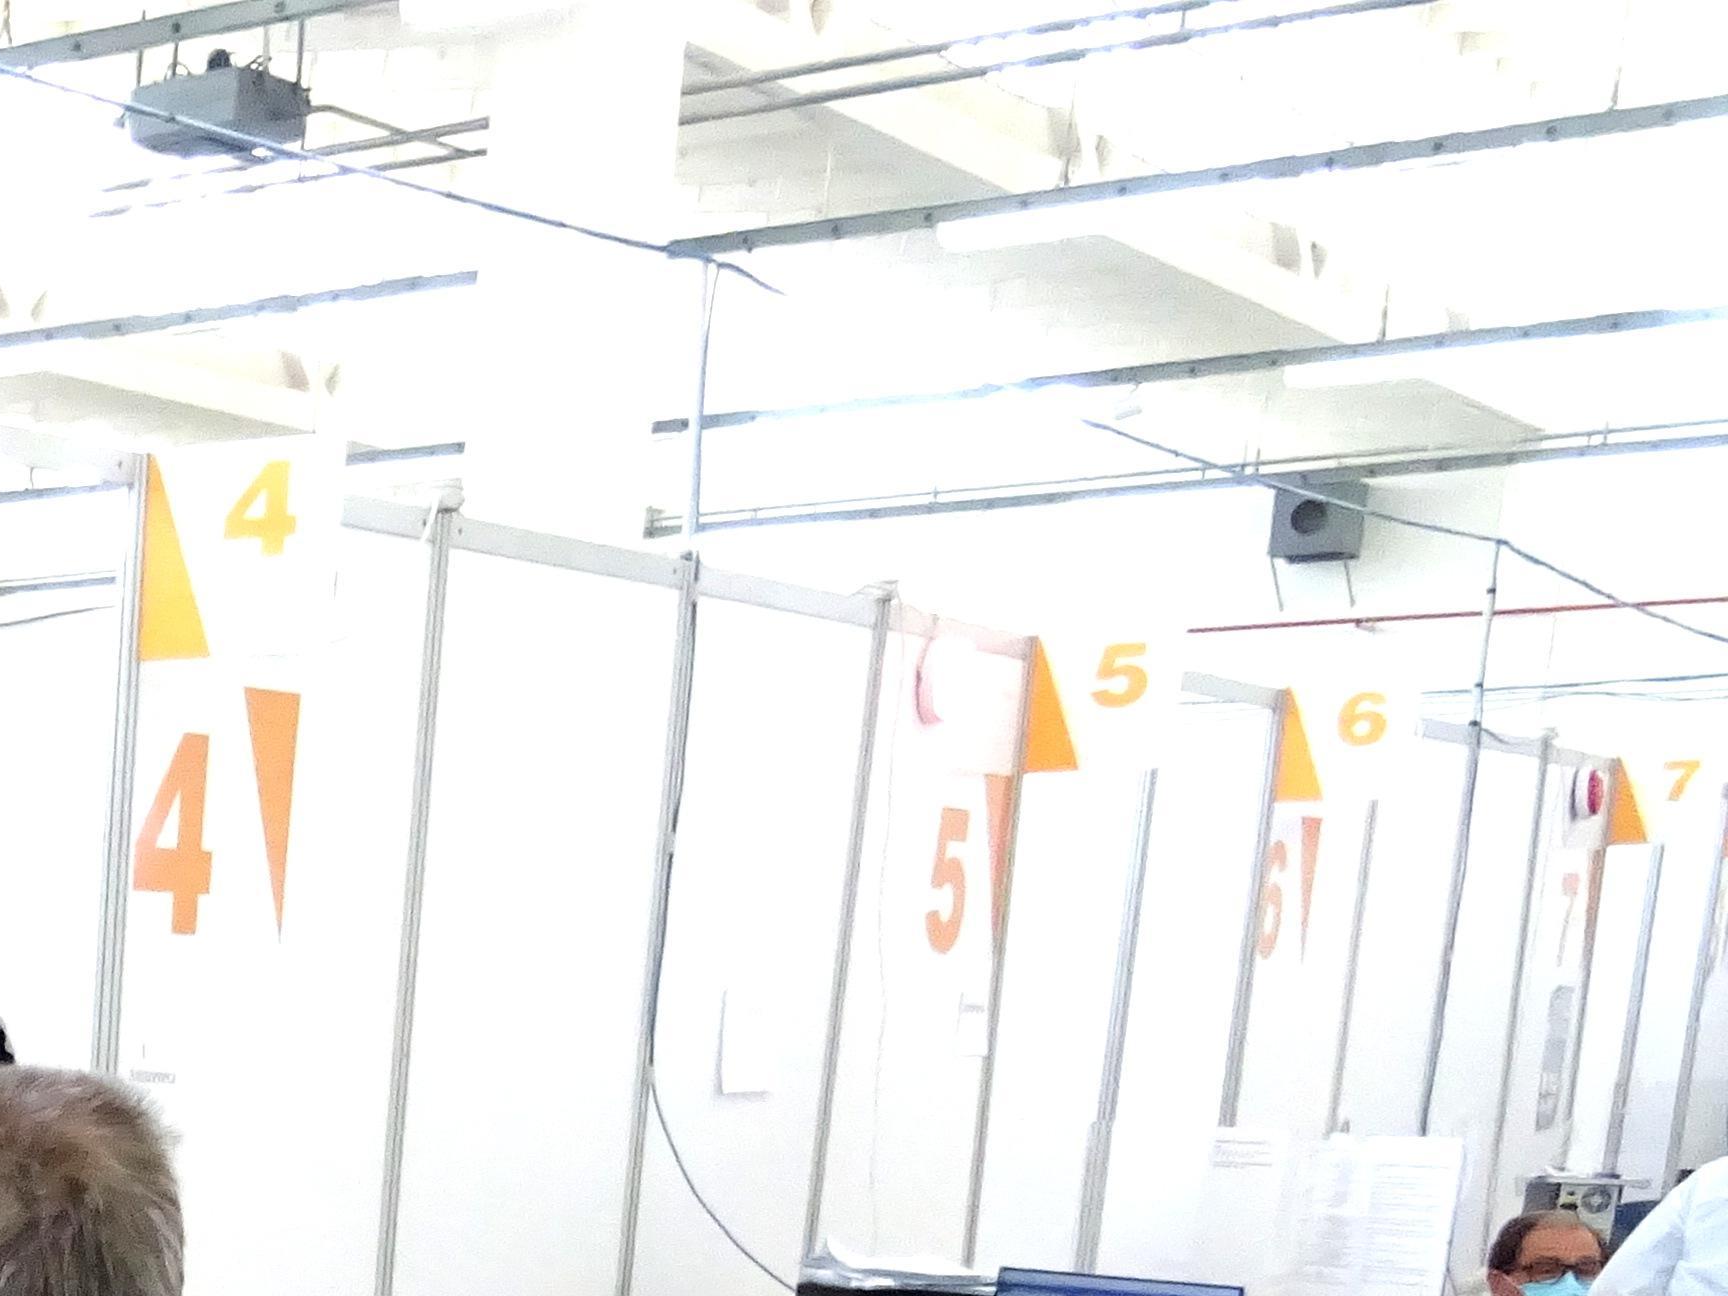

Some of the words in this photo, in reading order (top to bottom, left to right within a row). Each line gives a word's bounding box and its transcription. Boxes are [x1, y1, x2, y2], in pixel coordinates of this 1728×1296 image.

[224, 460, 298, 555] 4
[1090, 642, 1148, 708] 5
[1336, 692, 1388, 746] 6
[1663, 760, 1701, 801] 7
[132, 731, 213, 936] 4
[924, 806, 970, 955] 5
[1255, 839, 1288, 960] 6
